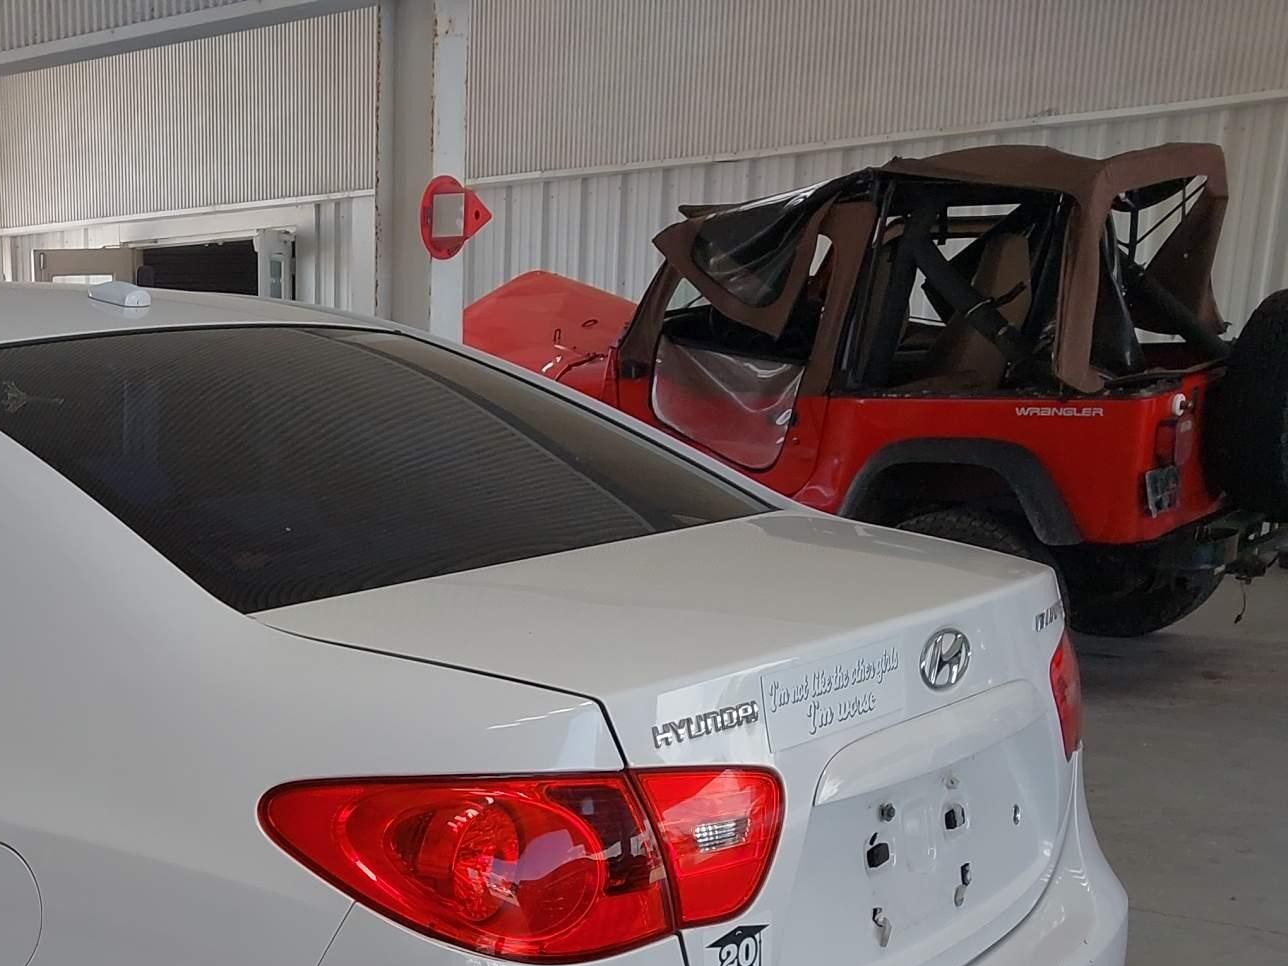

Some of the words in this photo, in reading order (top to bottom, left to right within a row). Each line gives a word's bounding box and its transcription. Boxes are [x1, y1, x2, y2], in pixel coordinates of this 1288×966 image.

[1015, 407, 1104, 417] WRANGLER
[769, 680, 791, 713] I'm
[791, 674, 810, 705] not
[811, 669, 833, 698] like
[831, 664, 850, 692] the
[851, 657, 876, 685] other
[876, 647, 899, 684] girls
[652, 700, 759, 749] HYUNDAI
[807, 700, 834, 735] I'm
[838, 692, 877, 721] worse
